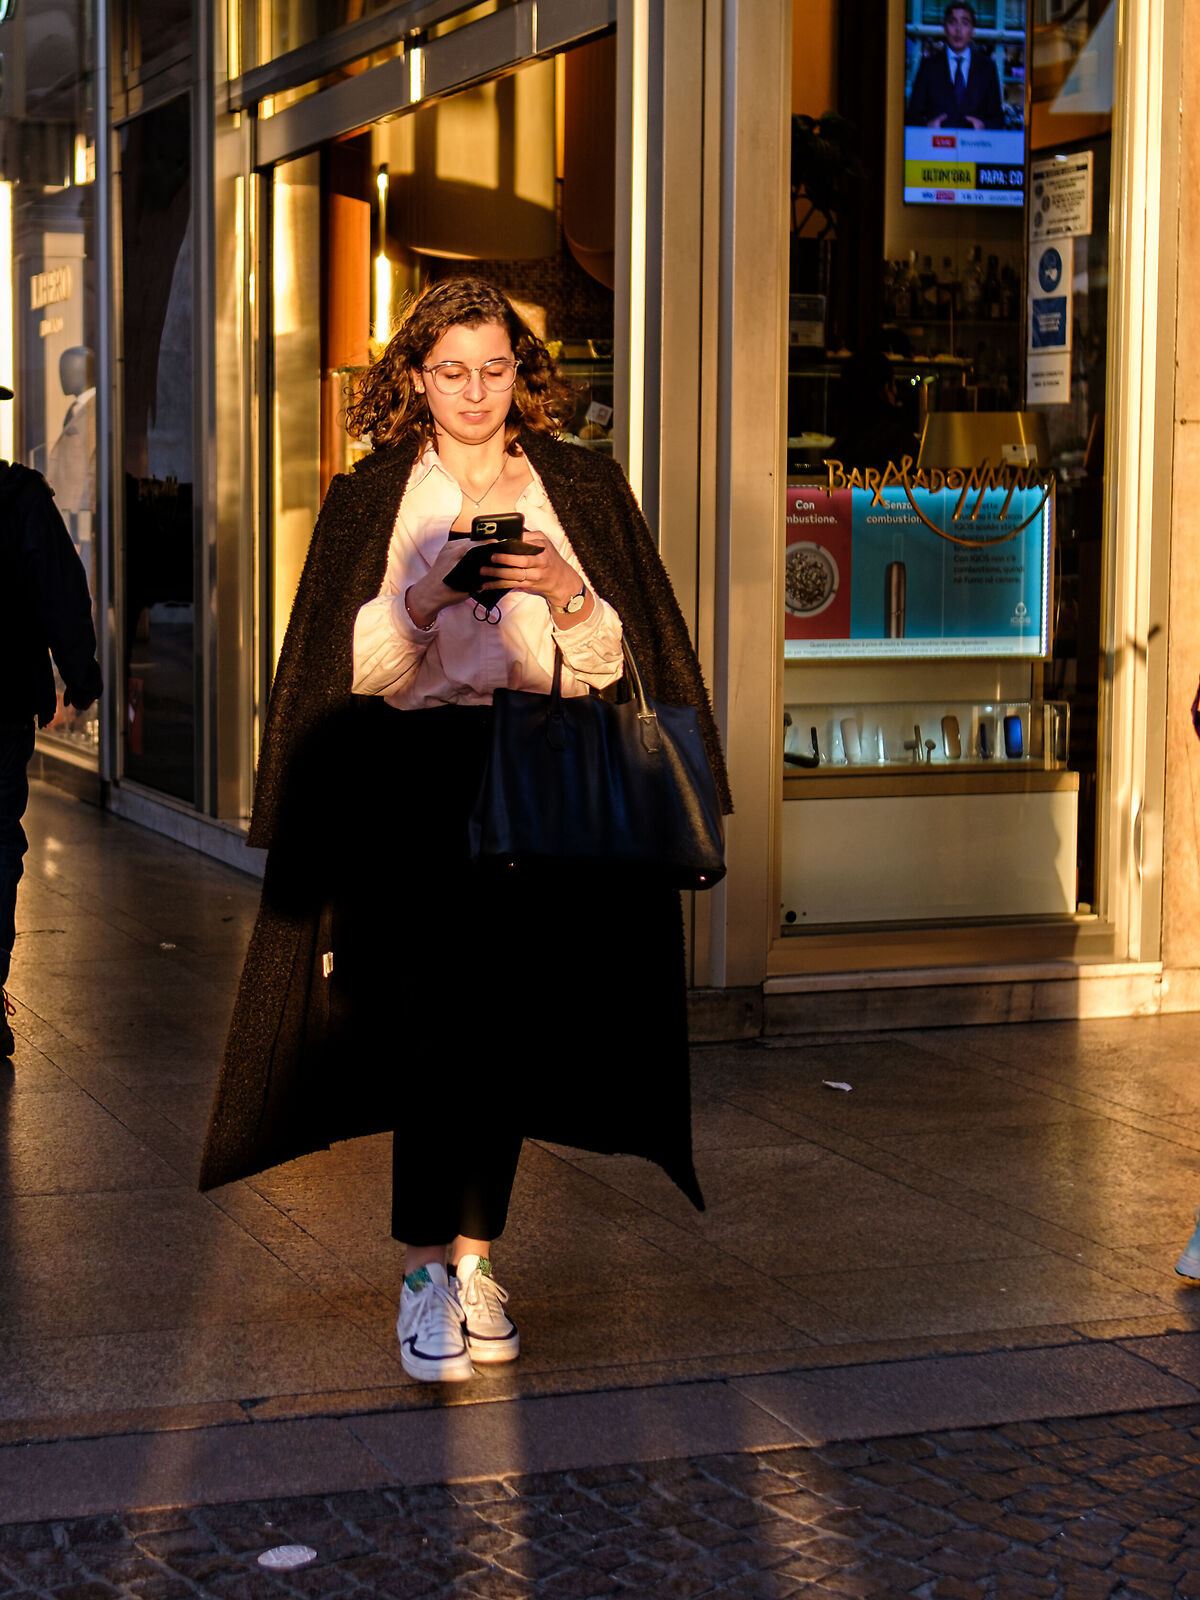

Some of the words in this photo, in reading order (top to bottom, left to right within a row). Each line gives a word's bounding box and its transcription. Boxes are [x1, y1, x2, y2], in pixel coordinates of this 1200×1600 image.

[795, 499, 815, 510] Con
[885, 500, 913, 510] Senza
[786, 513, 838, 524] mbustione.
[866, 514, 923, 524] combustion
